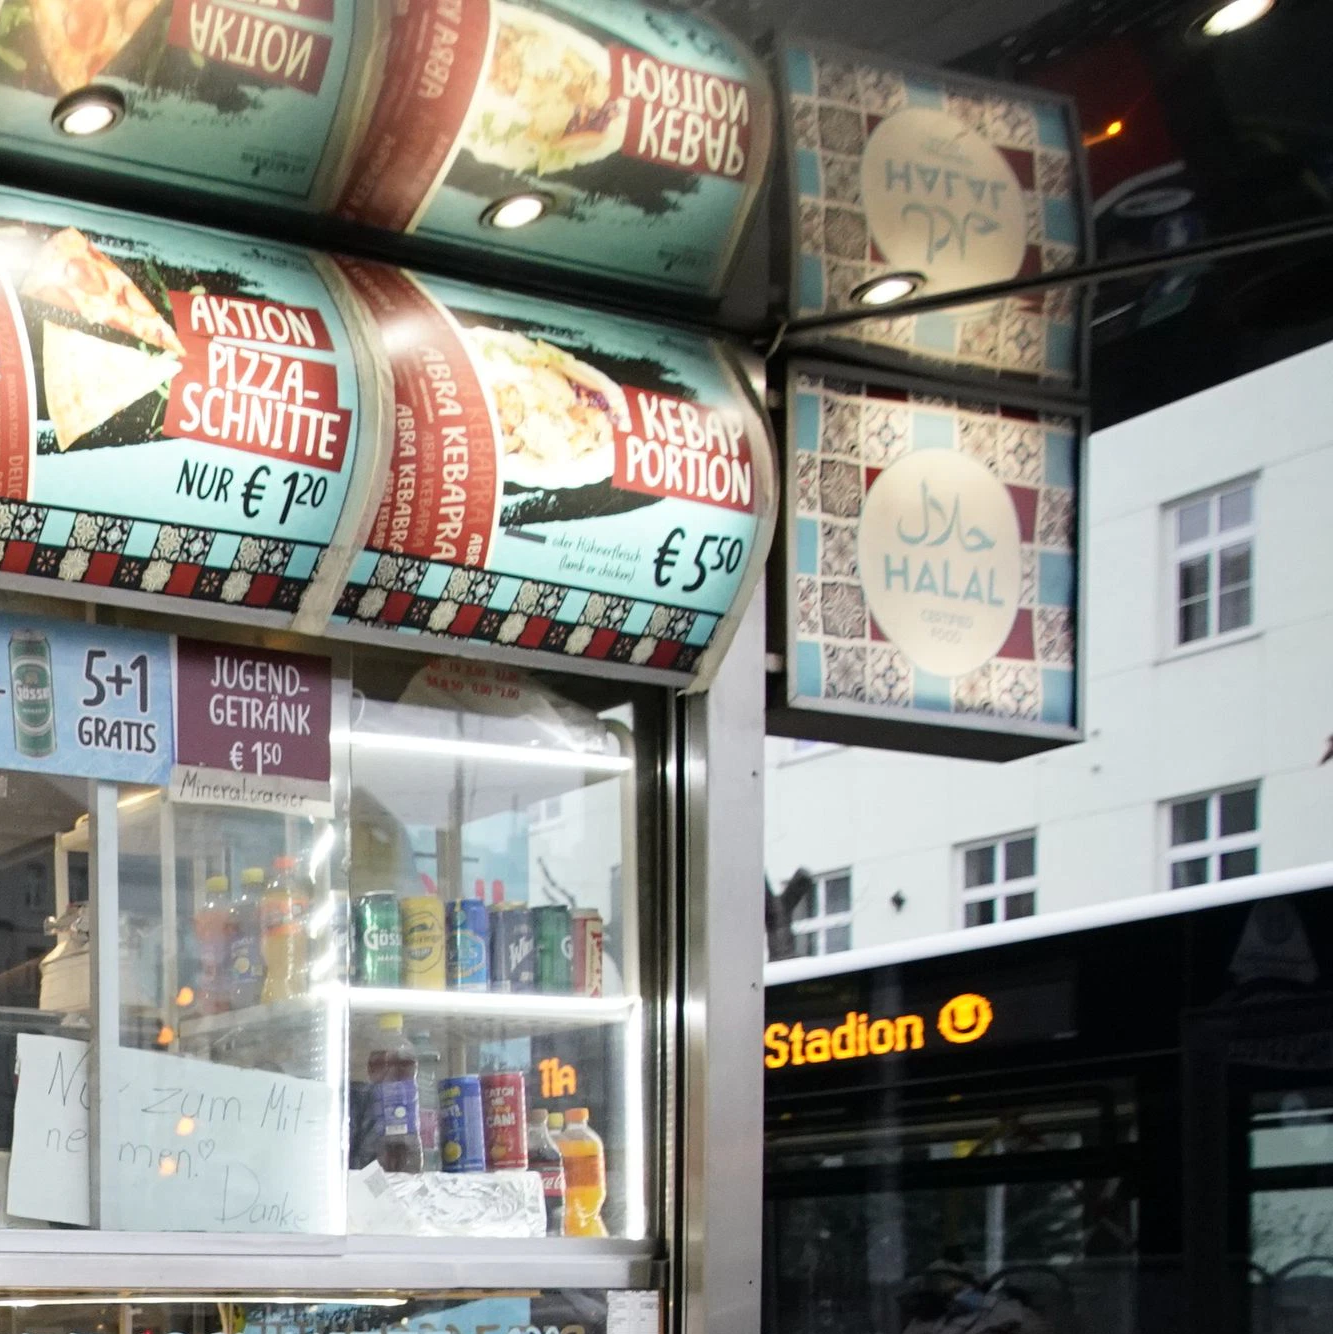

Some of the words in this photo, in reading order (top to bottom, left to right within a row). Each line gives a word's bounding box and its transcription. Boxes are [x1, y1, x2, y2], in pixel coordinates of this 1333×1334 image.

[191, 295, 316, 347] AKTION
[208, 341, 320, 405] PIZZA-
[179, 382, 341, 460] SCHNITTE
[638, 392, 744, 458] KEBAP
[176, 459, 234, 503] NUR
[625, 435, 751, 506] PORTION
[885, 553, 1005, 607] HALAL
[211, 656, 309, 697] JUGEND-
[78, 716, 156, 754] GRATIS
[209, 694, 311, 735] GETRÄNK
[764, 1011, 925, 1069] Stadion
